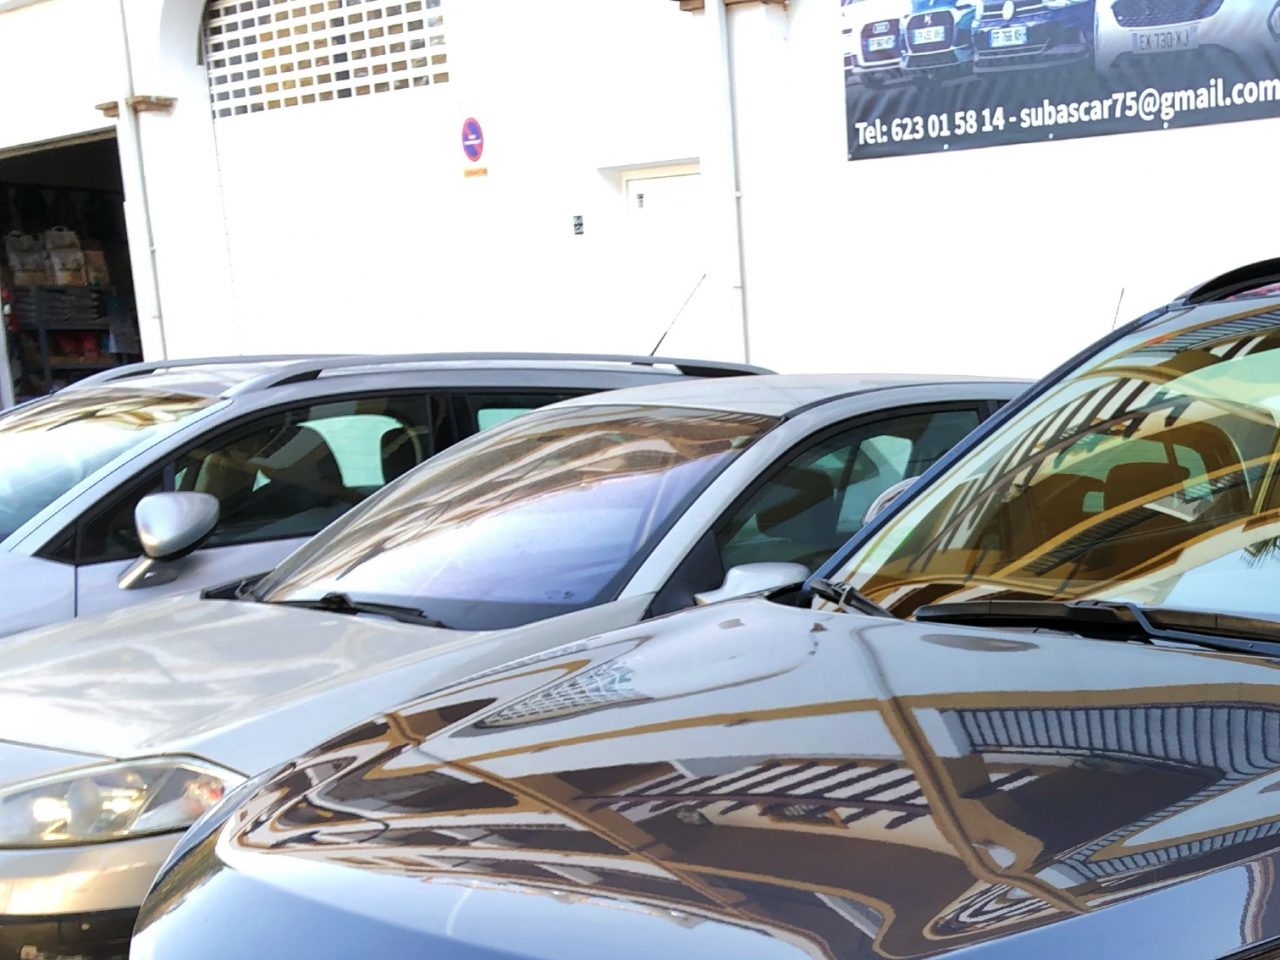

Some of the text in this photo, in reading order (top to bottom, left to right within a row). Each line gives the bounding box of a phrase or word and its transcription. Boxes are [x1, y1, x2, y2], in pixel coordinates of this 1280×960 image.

[855, 118, 888, 145] Tel:
[891, 116, 924, 142] 623
[927, 113, 951, 138] 01
[954, 110, 978, 135] 58
[981, 107, 1005, 132] 14
